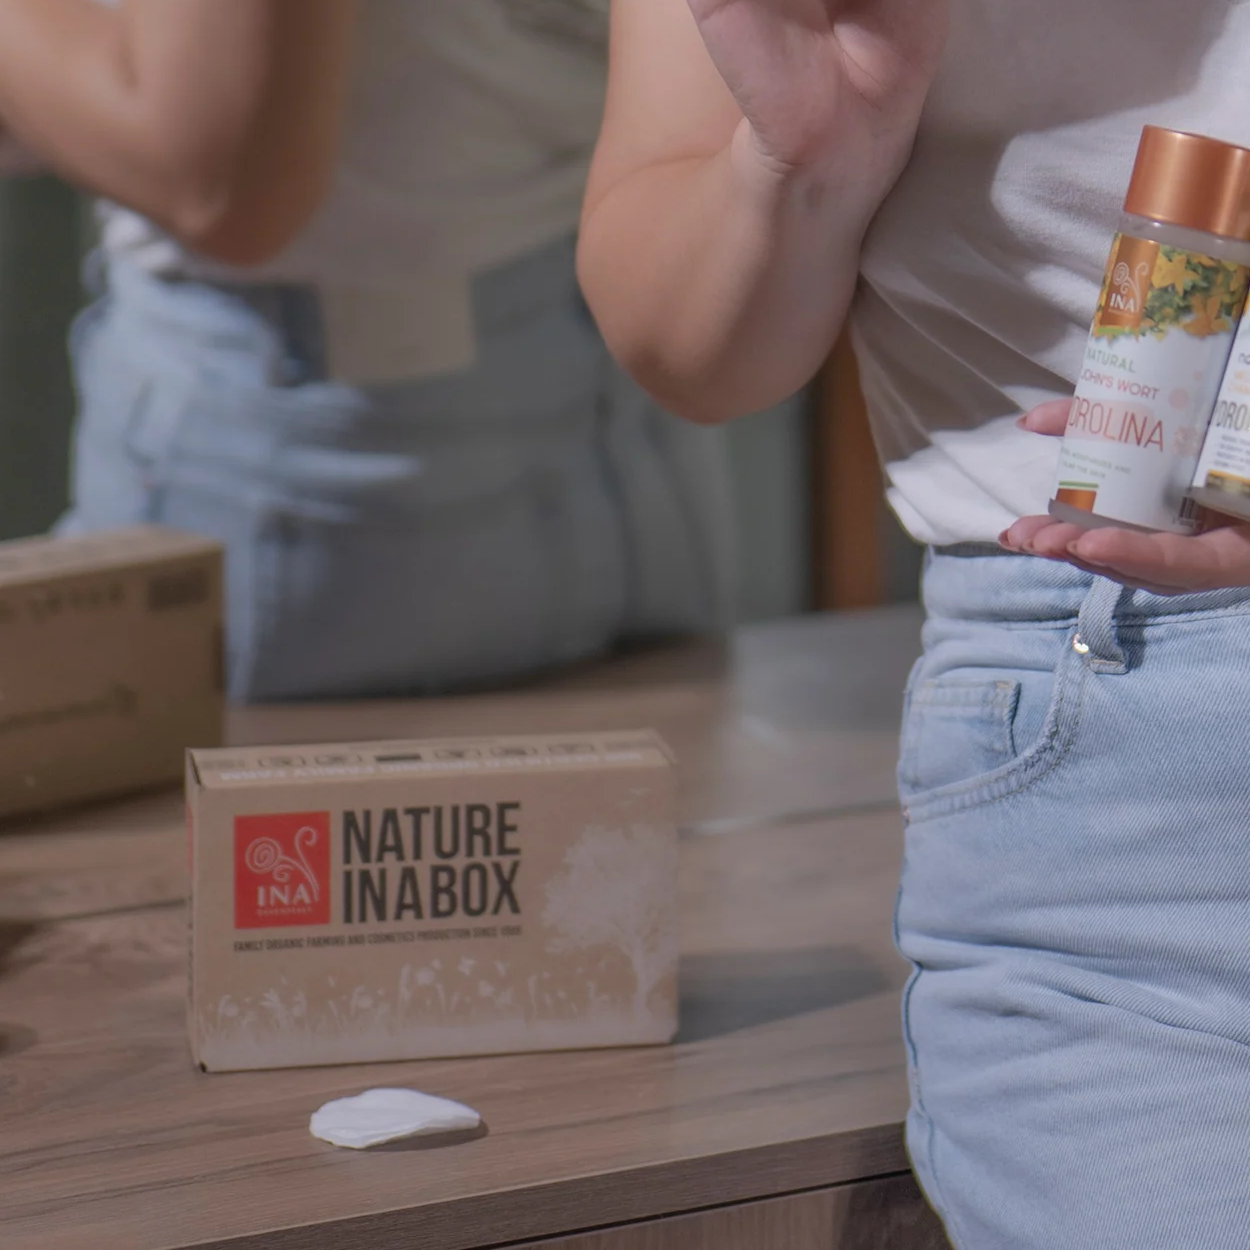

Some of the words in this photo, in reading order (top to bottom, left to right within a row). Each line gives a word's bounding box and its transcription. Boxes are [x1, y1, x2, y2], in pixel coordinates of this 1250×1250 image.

[1109, 292, 1134, 313] INA
[1117, 378, 1161, 401] WORT
[342, 801, 522, 866] NATURE
[257, 882, 313, 907] INA
